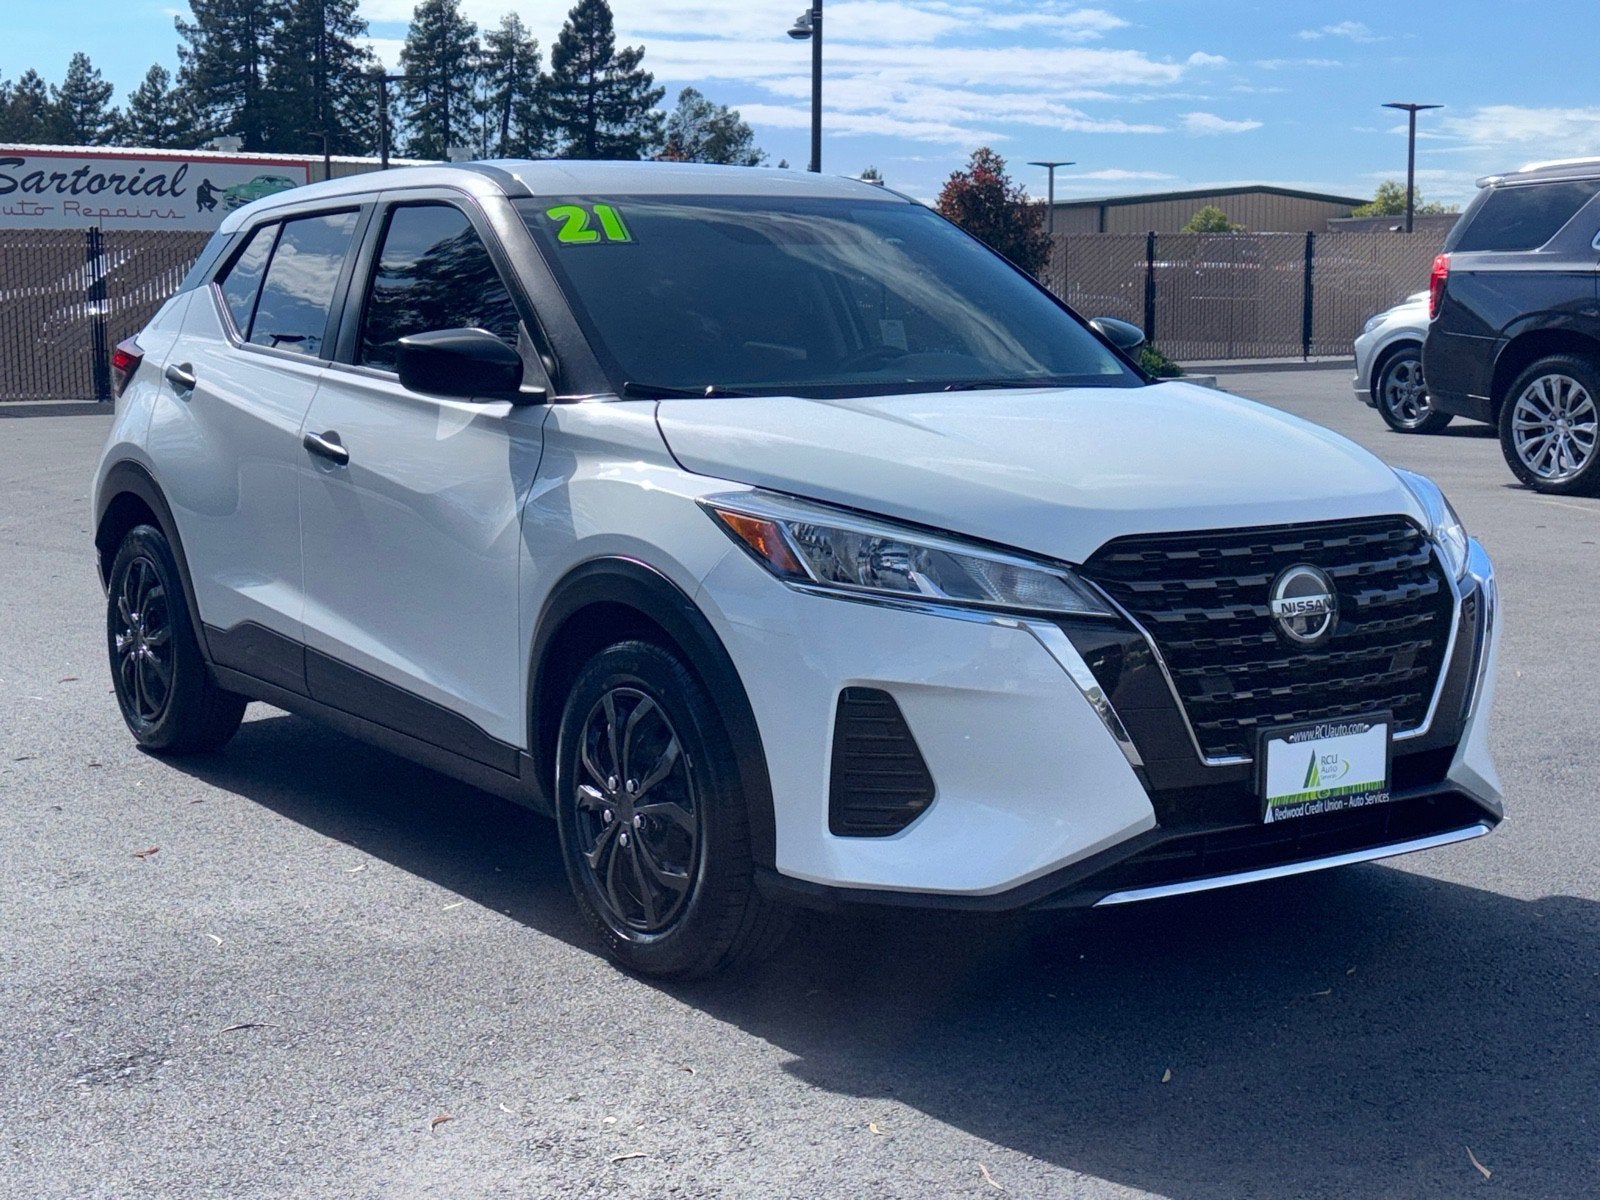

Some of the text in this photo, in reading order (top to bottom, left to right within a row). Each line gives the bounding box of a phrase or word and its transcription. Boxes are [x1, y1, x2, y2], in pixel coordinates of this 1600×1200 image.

[0, 157, 189, 198] Sartorial
[2, 200, 186, 229] uto Repairs
[546, 204, 632, 244] 21
[1281, 600, 1331, 613] NISSAN
[1293, 723, 1365, 742] www.RCUauto.com
[1321, 754, 1338, 765] RCU
[1274, 803, 1304, 821] Redwood
[1305, 800, 1323, 816] Credit
[1324, 797, 1343, 813] Union
[1349, 795, 1364, 808] Auto
[1365, 792, 1389, 806] Services
